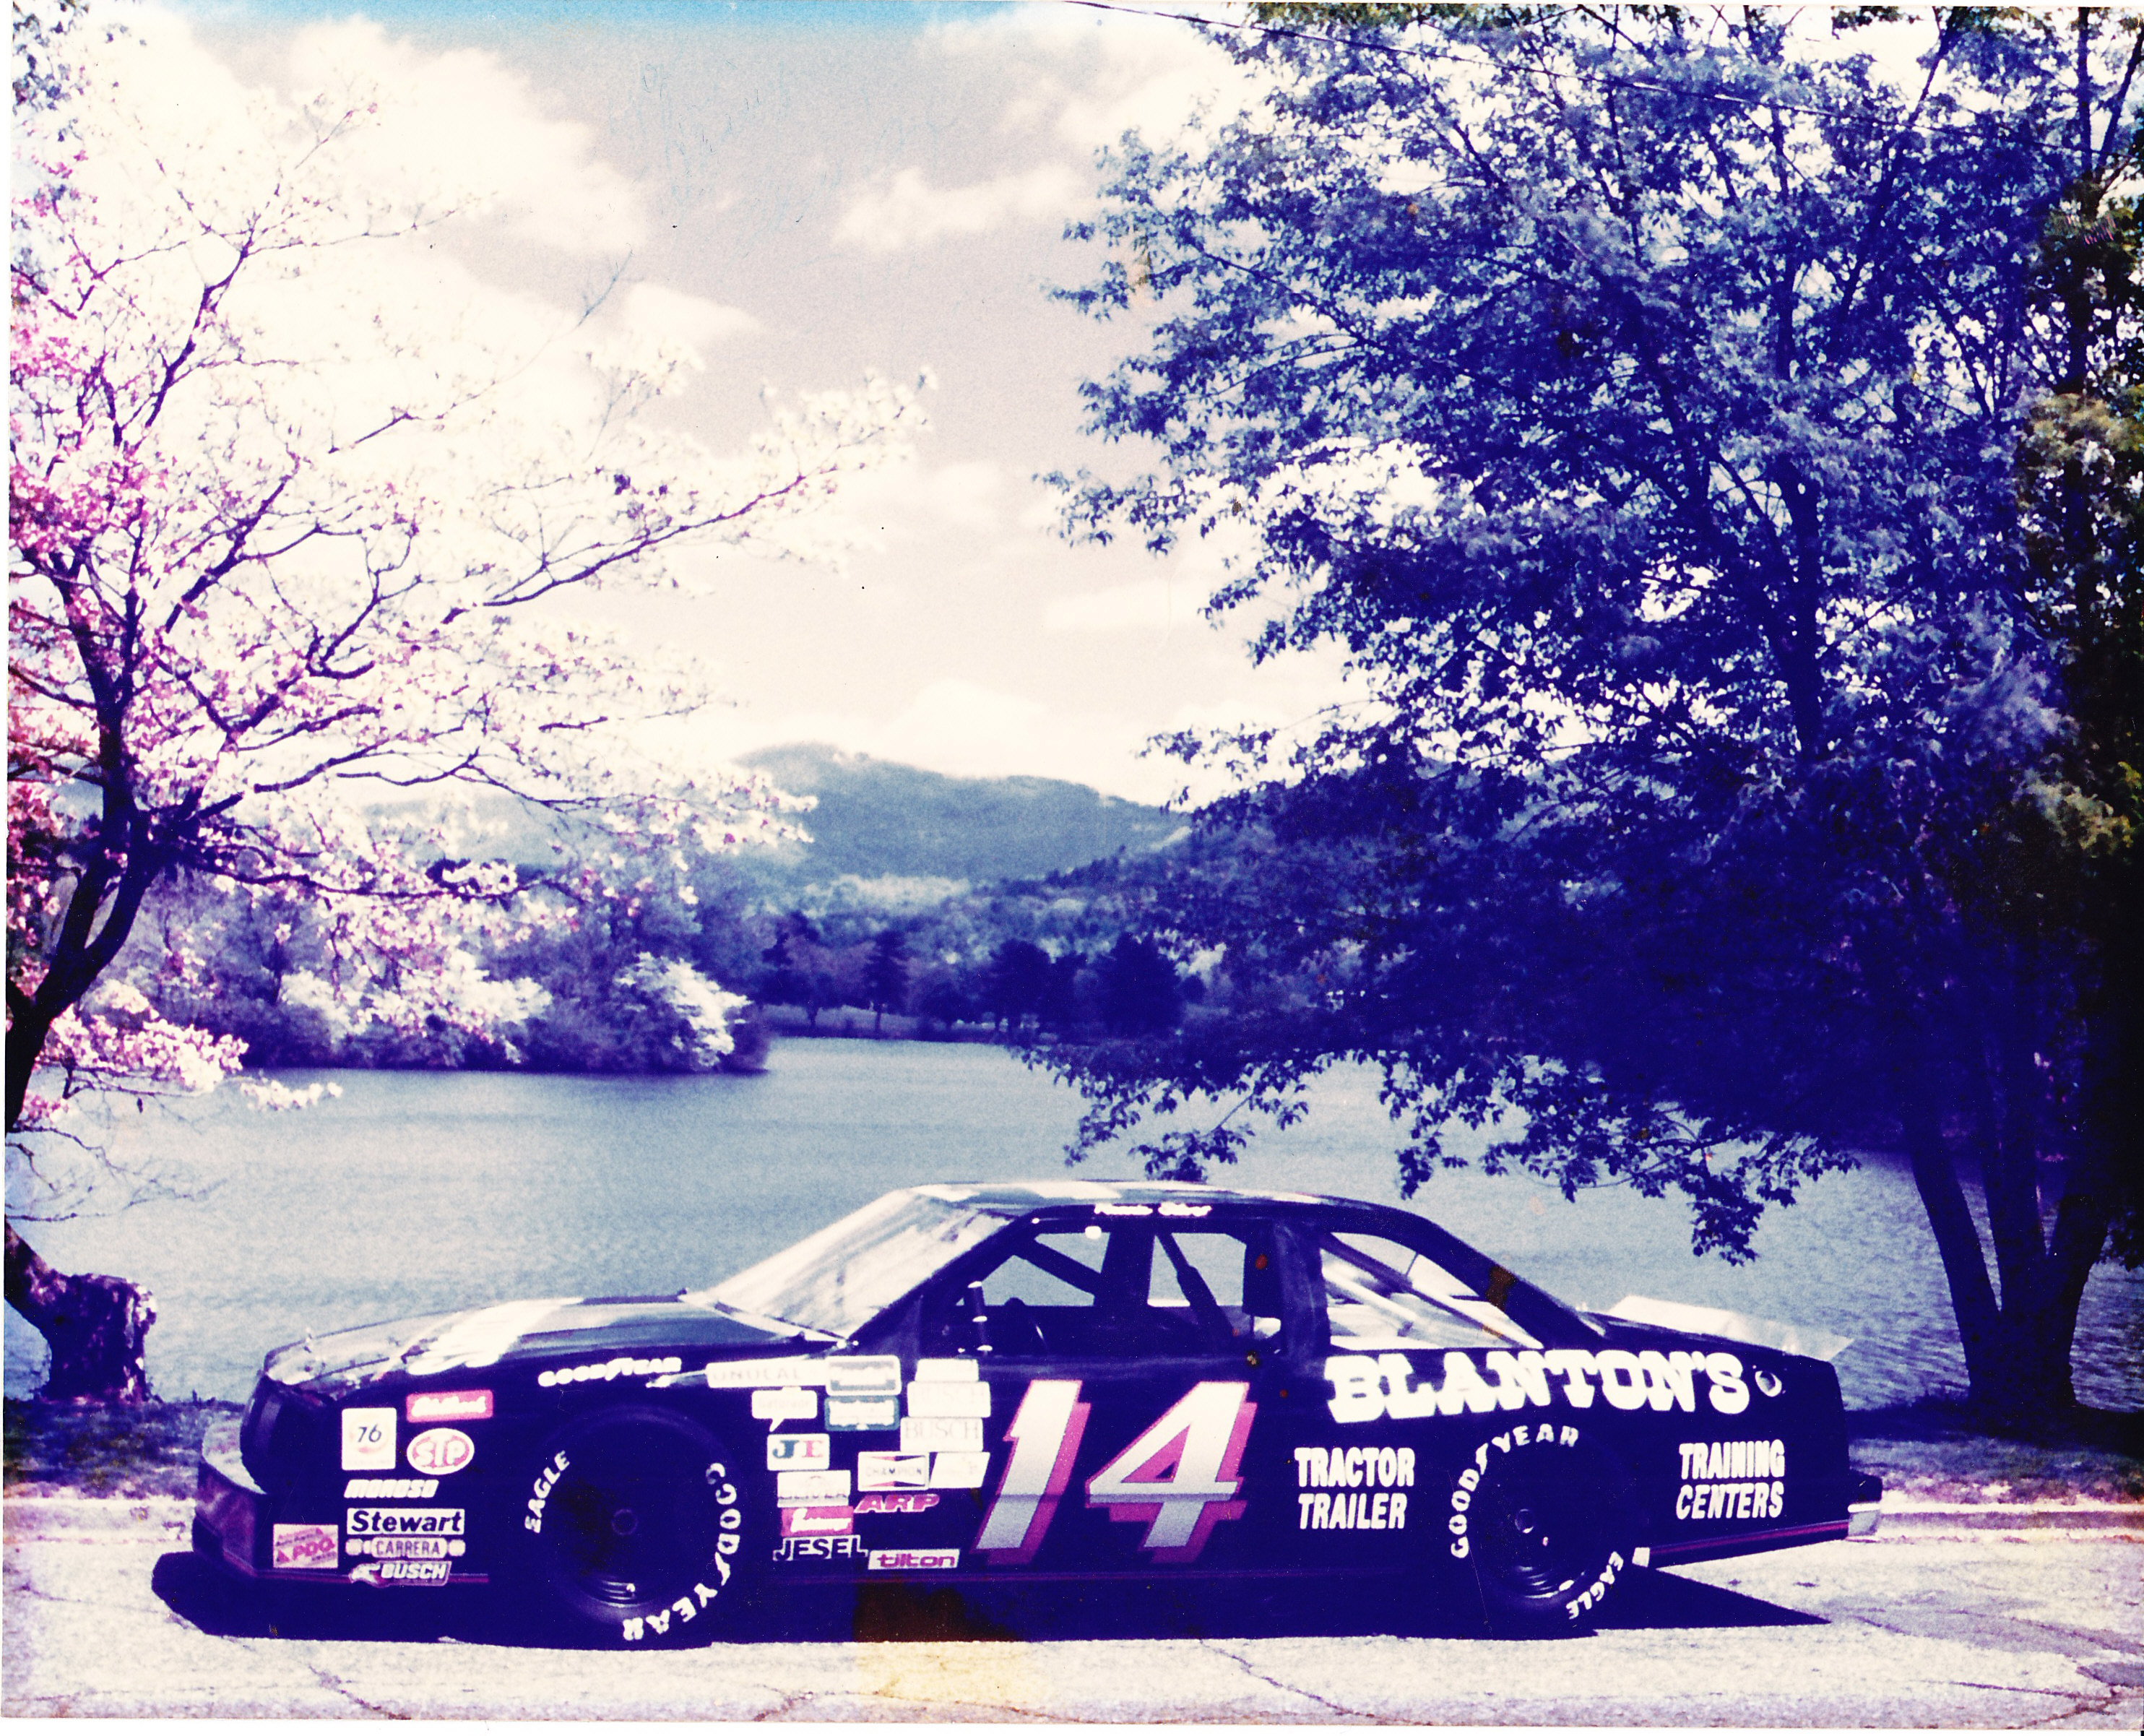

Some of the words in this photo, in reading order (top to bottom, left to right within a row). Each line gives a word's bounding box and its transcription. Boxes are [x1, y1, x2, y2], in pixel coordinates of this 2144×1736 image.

[1324, 1349, 1750, 1425] BLANTON'S
[358, 1424, 382, 1443] 76
[904, 1420, 980, 1441] BUSCH
[415, 1436, 466, 1466] STP
[772, 1440, 824, 1459] JE
[1679, 1439, 1786, 1480] TRAINING
[865, 1464, 922, 1478] CHAMPION
[969, 1379, 1258, 1565] 14
[1294, 1447, 1416, 1488] TRACTOR
[524, 1451, 570, 1534] EAGLE
[853, 1493, 940, 1513] ARP
[1449, 1423, 1579, 1560] GOODYEAR
[1675, 1482, 1785, 1521] CENTERS
[351, 1510, 462, 1532] Stewart
[1298, 1493, 1409, 1530] TRAILER
[376, 1541, 440, 1556] CARRERA
[772, 1534, 869, 1561] JESEL
[876, 1553, 956, 1568] tilton
[381, 1563, 447, 1579] BUSCH
[1565, 1552, 1625, 1621] EAGLE
